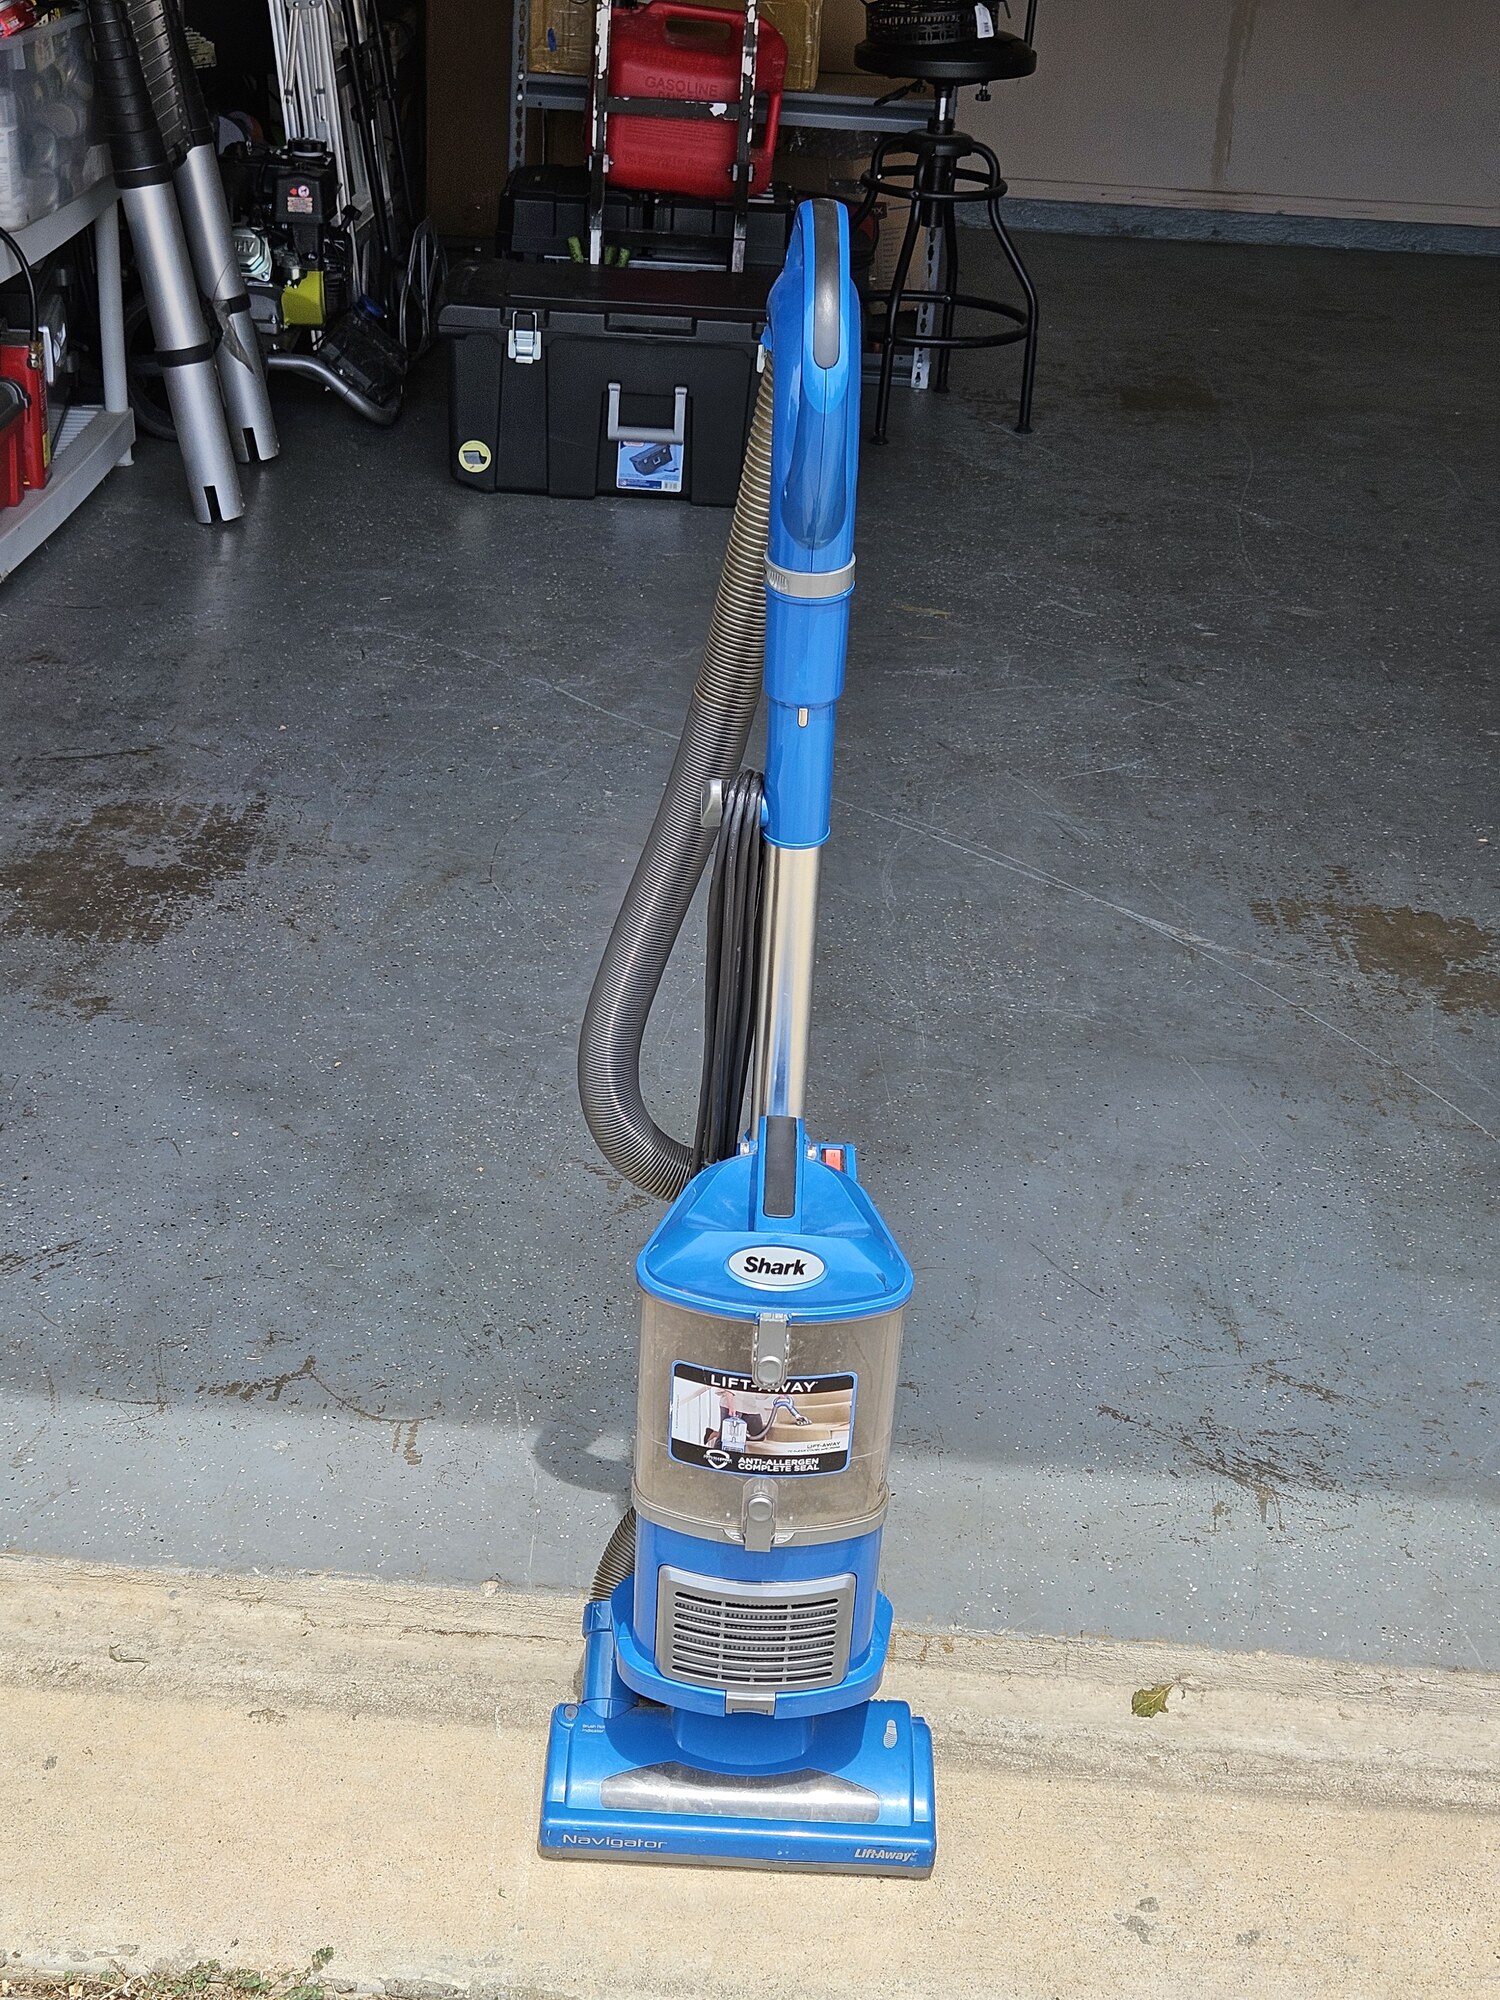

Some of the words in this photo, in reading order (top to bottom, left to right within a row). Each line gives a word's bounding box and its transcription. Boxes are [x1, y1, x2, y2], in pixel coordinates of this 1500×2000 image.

[645, 76, 718, 98] GASOLINE
[744, 1256, 807, 1275] Shark
[738, 1457, 819, 1466] ANTI-ALLERGEN
[738, 1463, 792, 1472] COMPLETE
[794, 1464, 820, 1472] SEAL
[562, 1834, 668, 1849] Navigator
[854, 1848, 912, 1862] Lift-Away
